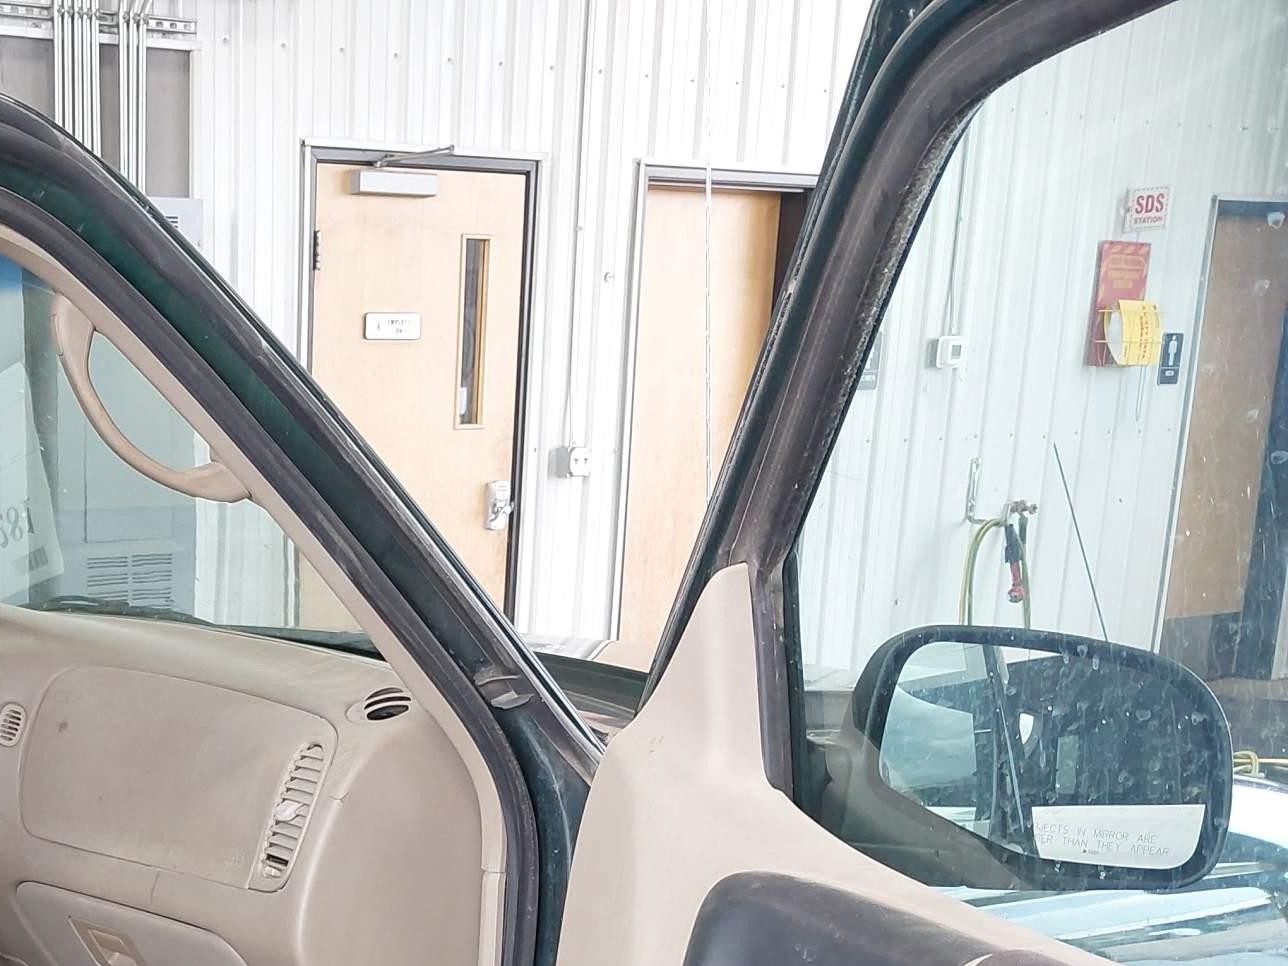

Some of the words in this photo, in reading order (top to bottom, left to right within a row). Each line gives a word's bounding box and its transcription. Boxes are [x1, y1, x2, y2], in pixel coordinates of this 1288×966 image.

[1135, 192, 1166, 214] SDS
[1077, 827, 1087, 837] IN
[1093, 829, 1129, 841] MIRROR
[1137, 834, 1158, 844] ARE
[1062, 836, 1088, 848] THAN
[1097, 840, 1120, 851] THEY
[1130, 844, 1170, 856] APPEAR
